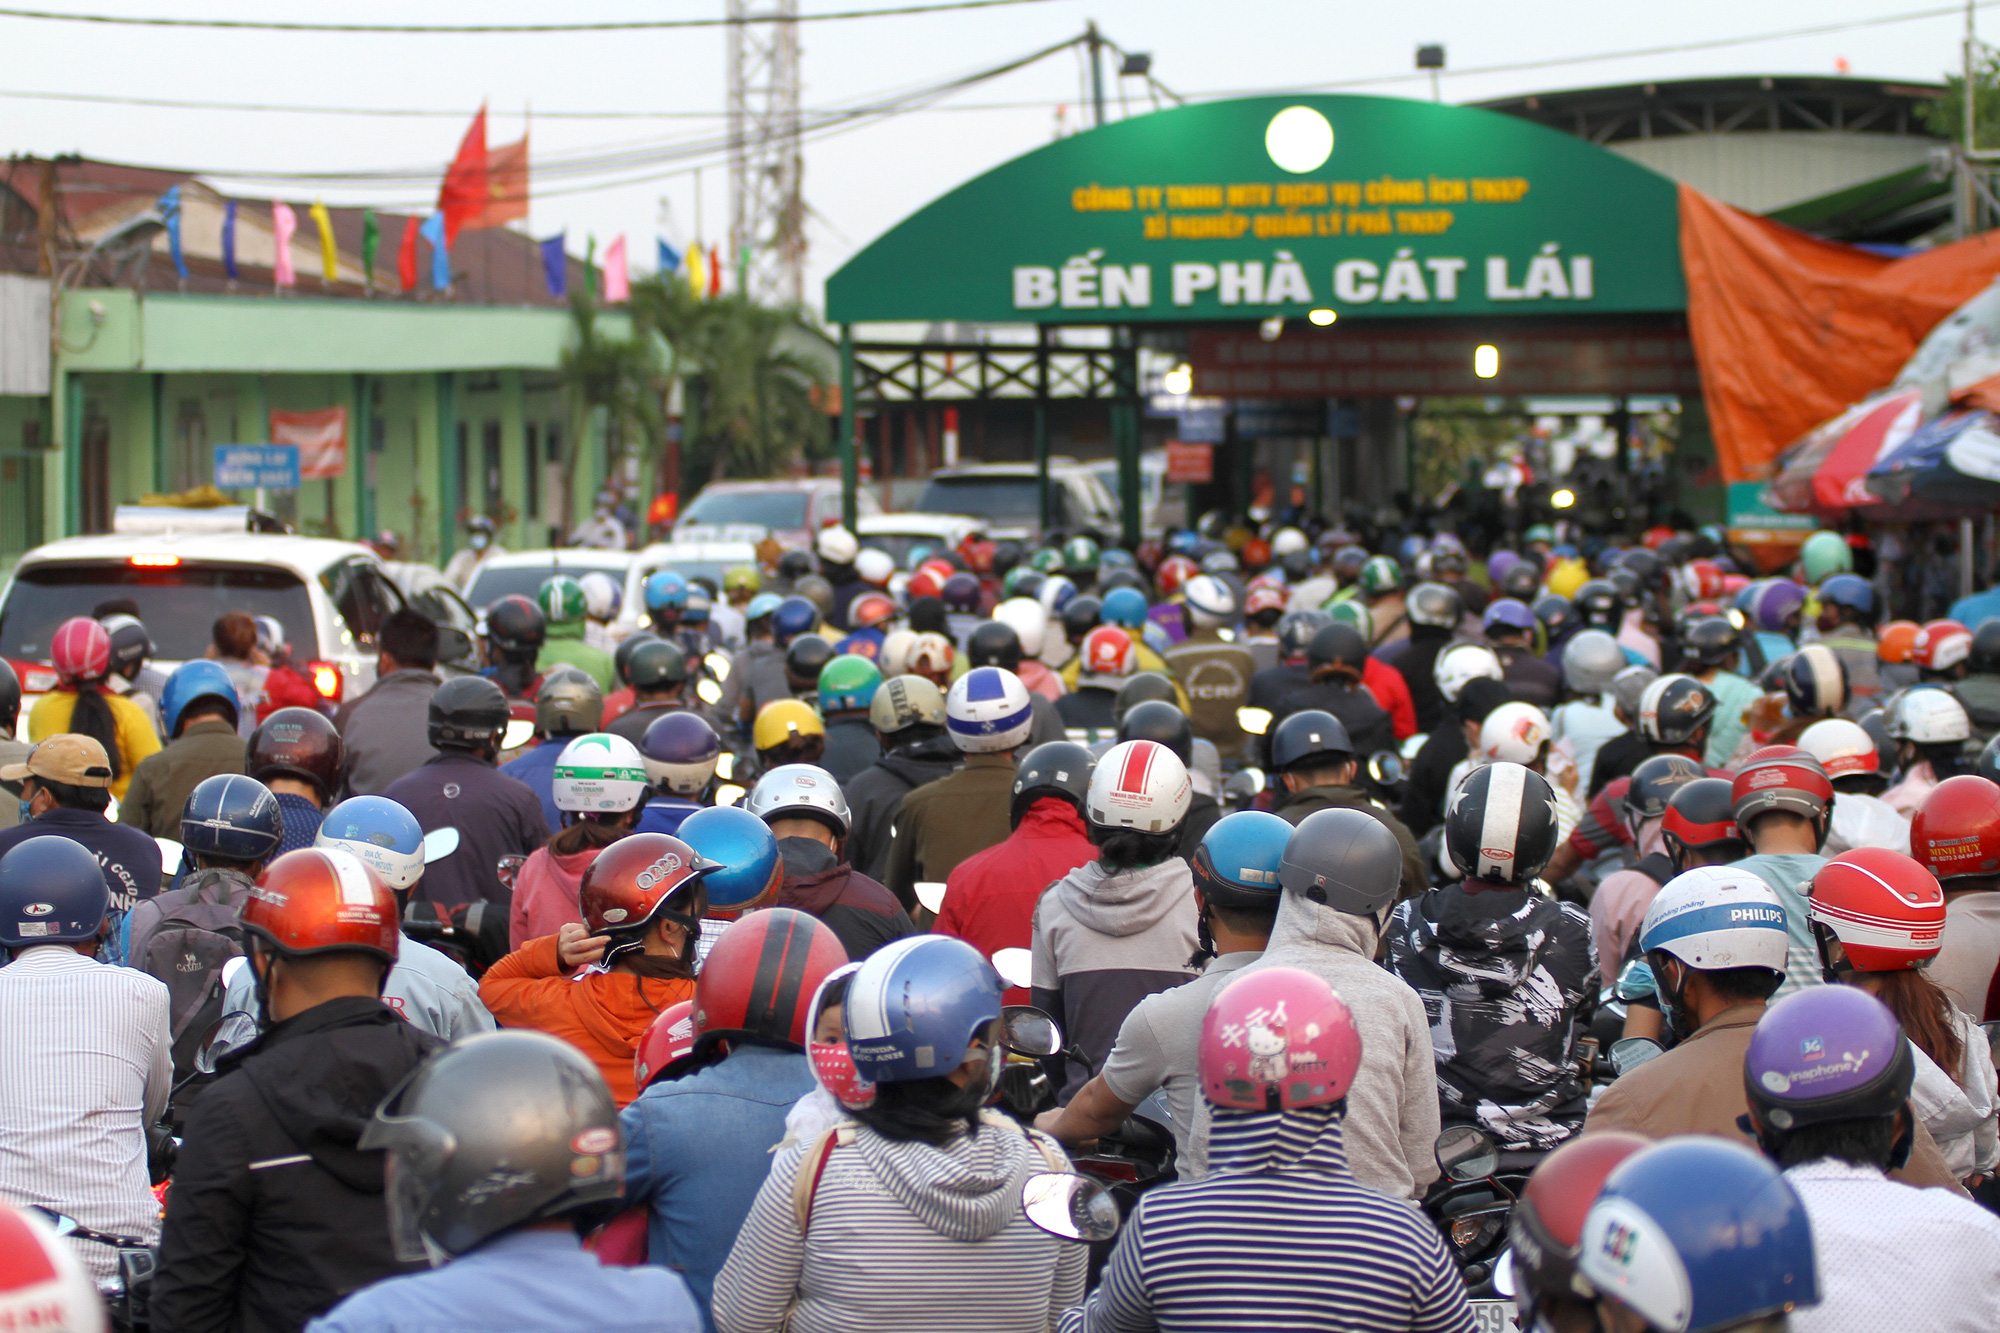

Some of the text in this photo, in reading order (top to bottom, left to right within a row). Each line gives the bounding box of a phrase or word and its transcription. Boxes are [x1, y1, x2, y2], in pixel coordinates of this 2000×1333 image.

[1012, 241, 1594, 309] BẾN PHÀ CÁT LÁI
[1930, 843, 1980, 856] MINH HUY
[1731, 908, 1783, 924] PHILIPS
[176, 961, 204, 972] CAMEL
[668, 1033, 693, 1043] HON
[1291, 1061, 1329, 1074] KITTY
[1475, 1304, 1504, 1333] 59
